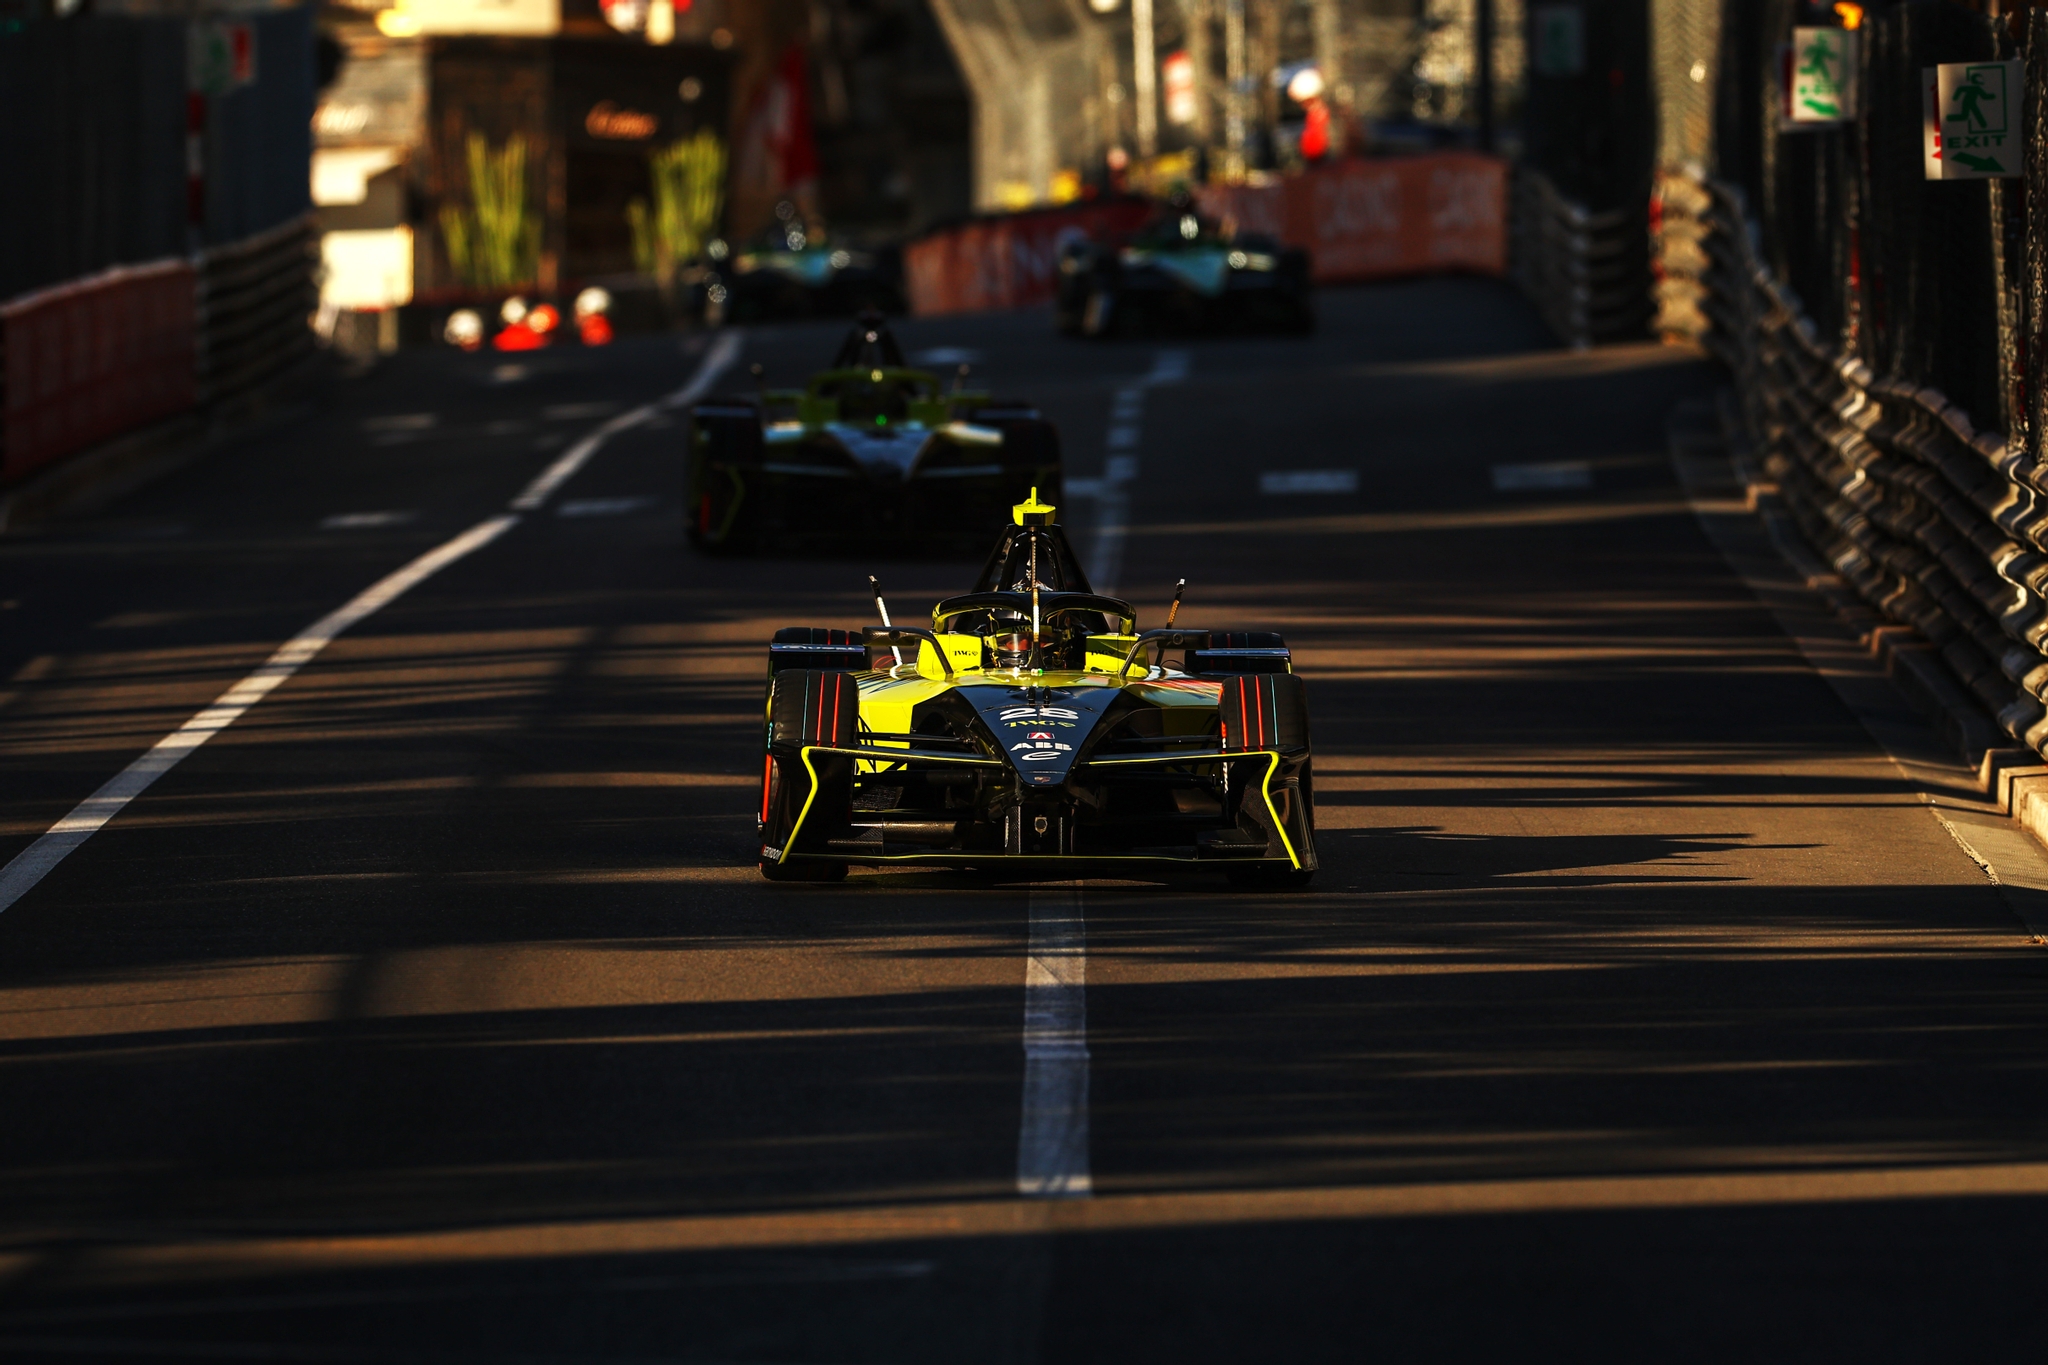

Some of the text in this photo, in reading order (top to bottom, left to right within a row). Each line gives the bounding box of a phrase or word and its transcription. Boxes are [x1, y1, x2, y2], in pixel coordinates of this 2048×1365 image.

[1948, 134, 2007, 149] EXIT
[999, 707, 1079, 721] 28
[1010, 741, 1073, 751] ABB
